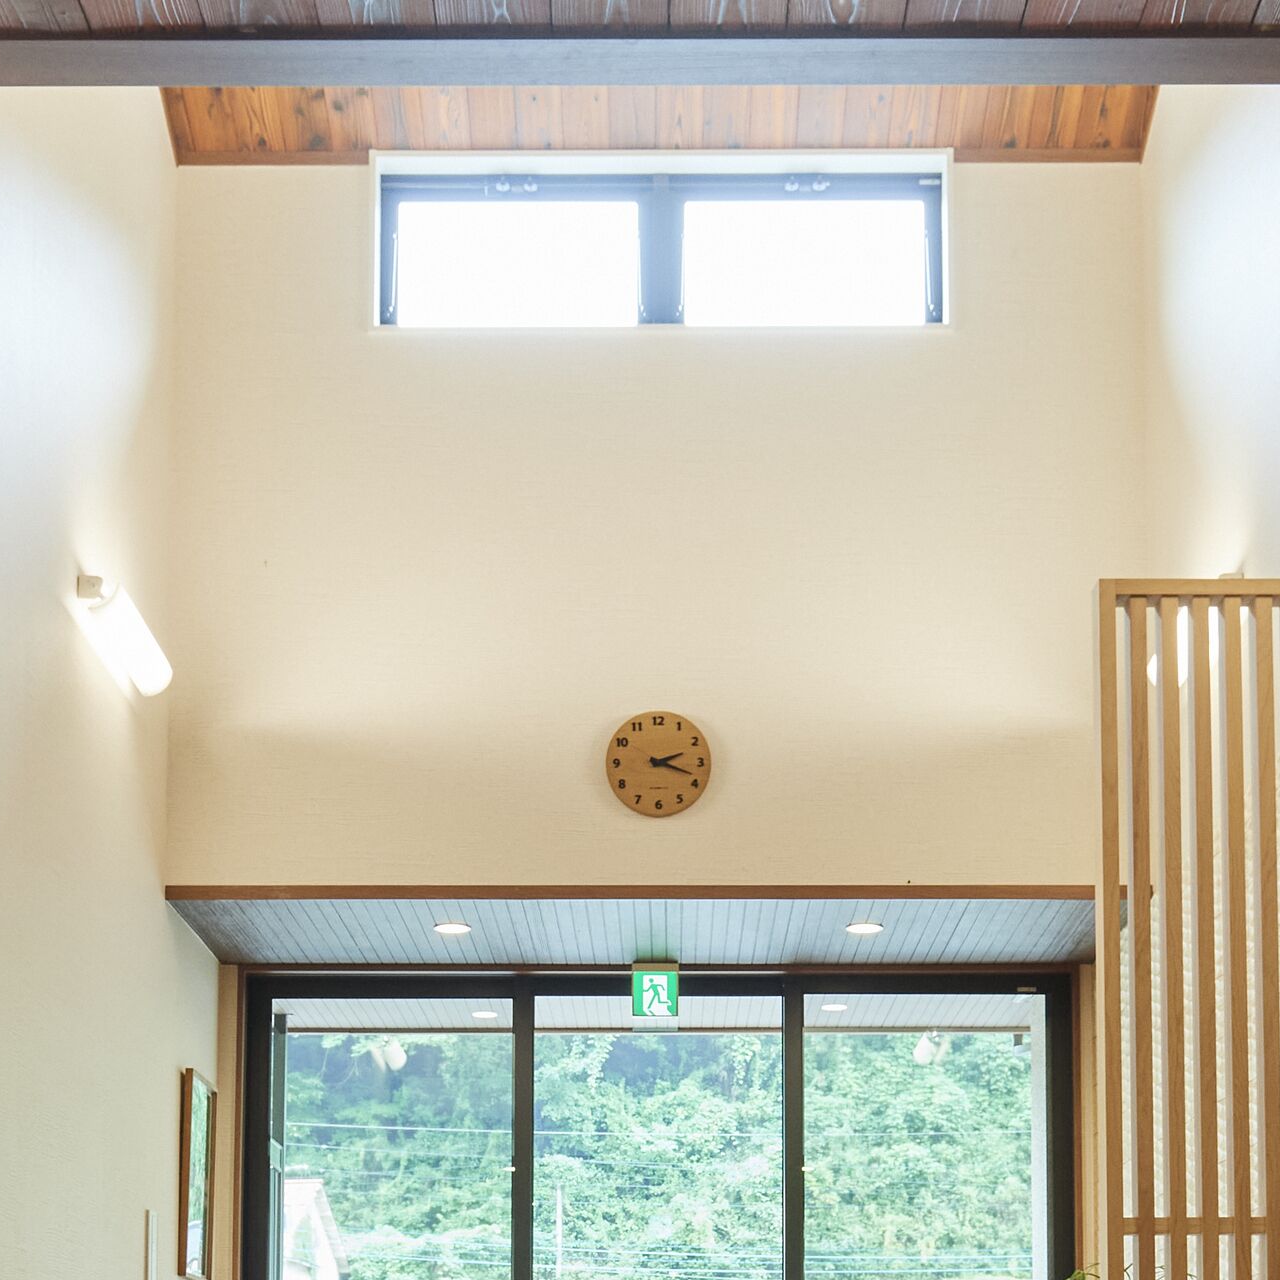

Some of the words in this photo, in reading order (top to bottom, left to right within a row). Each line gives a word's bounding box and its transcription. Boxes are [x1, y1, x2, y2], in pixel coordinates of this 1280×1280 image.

[652, 716, 665, 726] 12
[676, 721, 682, 731] 1
[631, 722, 643, 732] 11
[616, 737, 629, 747] 10
[691, 736, 699, 747] 2
[612, 758, 621, 768] 9
[696, 757, 705, 767] 3
[618, 779, 626, 789] 8
[690, 779, 699, 789] 4
[634, 795, 642, 805] 7
[676, 794, 684, 804] 5
[654, 800, 663, 810] 6
